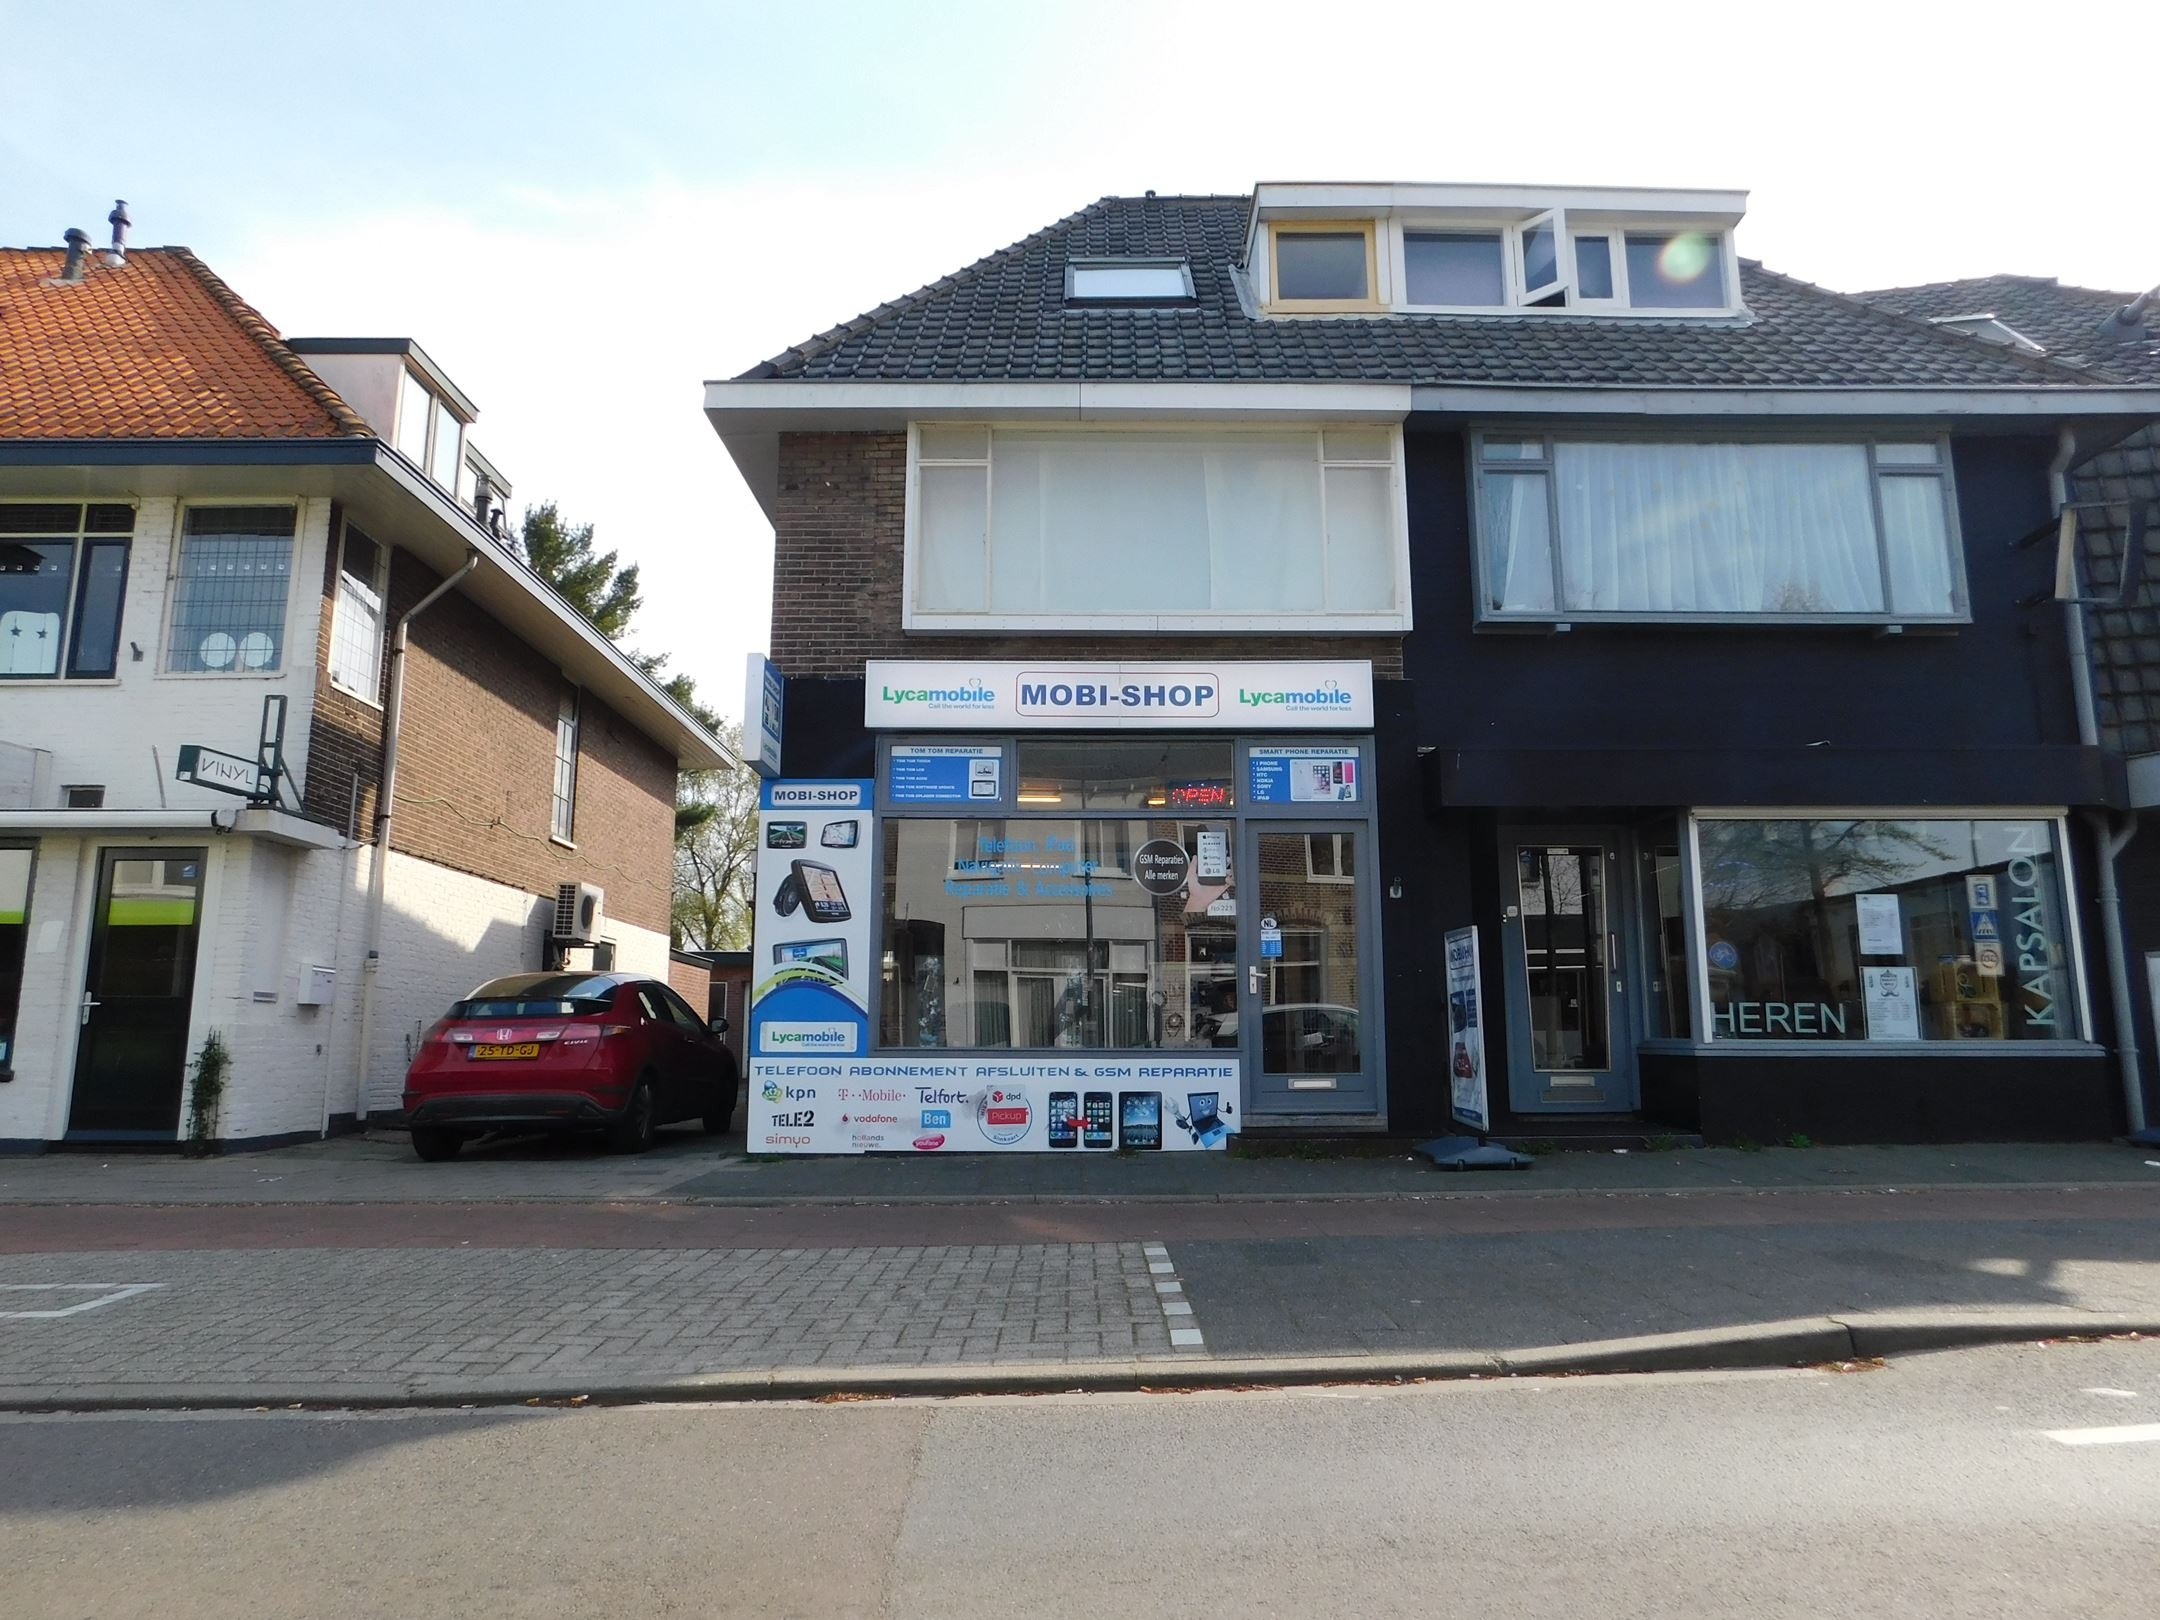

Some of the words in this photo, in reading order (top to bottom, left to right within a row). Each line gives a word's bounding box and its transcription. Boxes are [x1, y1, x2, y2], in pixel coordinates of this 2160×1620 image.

[882, 686, 995, 704] Lycamobile
[1020, 684, 1214, 707] MOBI-SHOP
[1239, 688, 1352, 706] Lycamobile
[202, 757, 253, 785] VINYL
[774, 790, 858, 801] MOBI-SHOP
[1172, 787, 1226, 802] OPEN
[1139, 854, 1153, 864] GSM
[1154, 854, 1184, 867] Reparaties
[1144, 869, 1156, 880] Alle
[1156, 870, 1179, 880] merken
[1263, 920, 1274, 928] NL
[2003, 826, 2056, 1026] KAPSALON
[1710, 1001, 1846, 1034] HEREN
[772, 1031, 846, 1044] Lycamobile
[479, 1045, 534, 1056] 25-TD-GJ
[754, 1065, 842, 1076] TELEFOON
[849, 1065, 968, 1077] ABONNEMENT
[976, 1066, 1070, 1077] AFSLUITEN
[1074, 1067, 1089, 1077] &
[1094, 1067, 1131, 1078] GSM
[1139, 1067, 1233, 1078] REPARATIE
[786, 1085, 816, 1101] kpn
[1006, 1092, 1021, 1103] dpd
[771, 1110, 815, 1127] TELE2
[853, 1114, 898, 1123] vodafone
[924, 1112, 946, 1125] Ben
[991, 1111, 1022, 1121] Pickup
[765, 1133, 811, 1148] simyo
